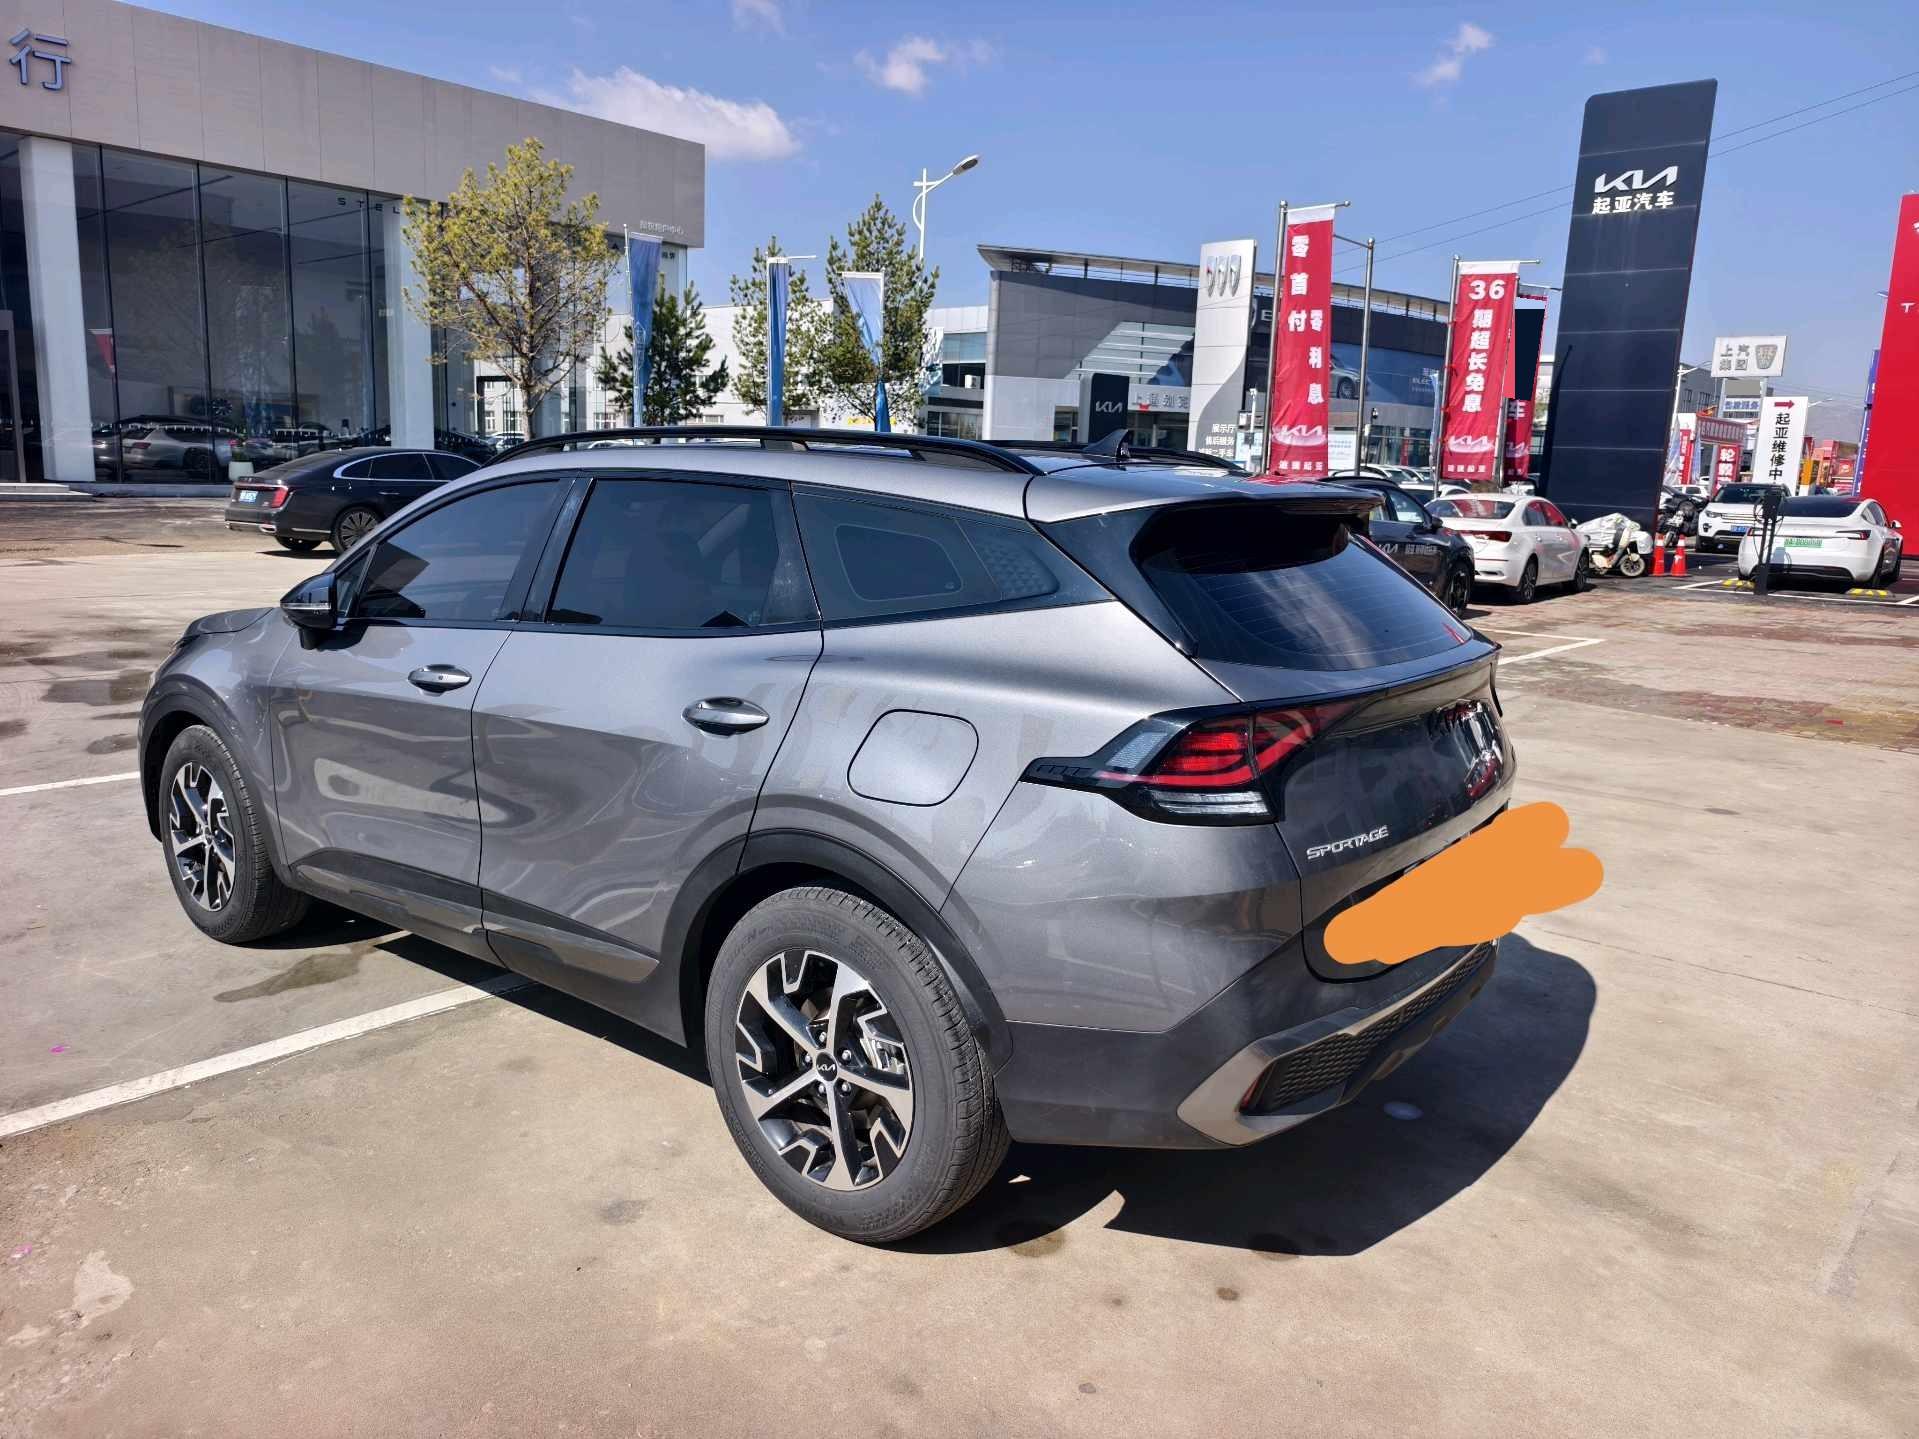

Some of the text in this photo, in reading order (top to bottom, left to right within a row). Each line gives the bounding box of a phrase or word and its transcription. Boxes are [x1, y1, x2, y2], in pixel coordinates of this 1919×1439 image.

[9, 28, 72, 91] 行
[1592, 191, 1675, 215] 起亚汽车
[1594, 166, 1679, 193] KIA
[1287, 234, 1310, 332] 零首付
[1468, 279, 1507, 300] 36
[1307, 309, 1324, 404] 零利息
[1768, 412, 1791, 484] 起亚维修中
[1306, 825, 1390, 859] SPORTAGE
